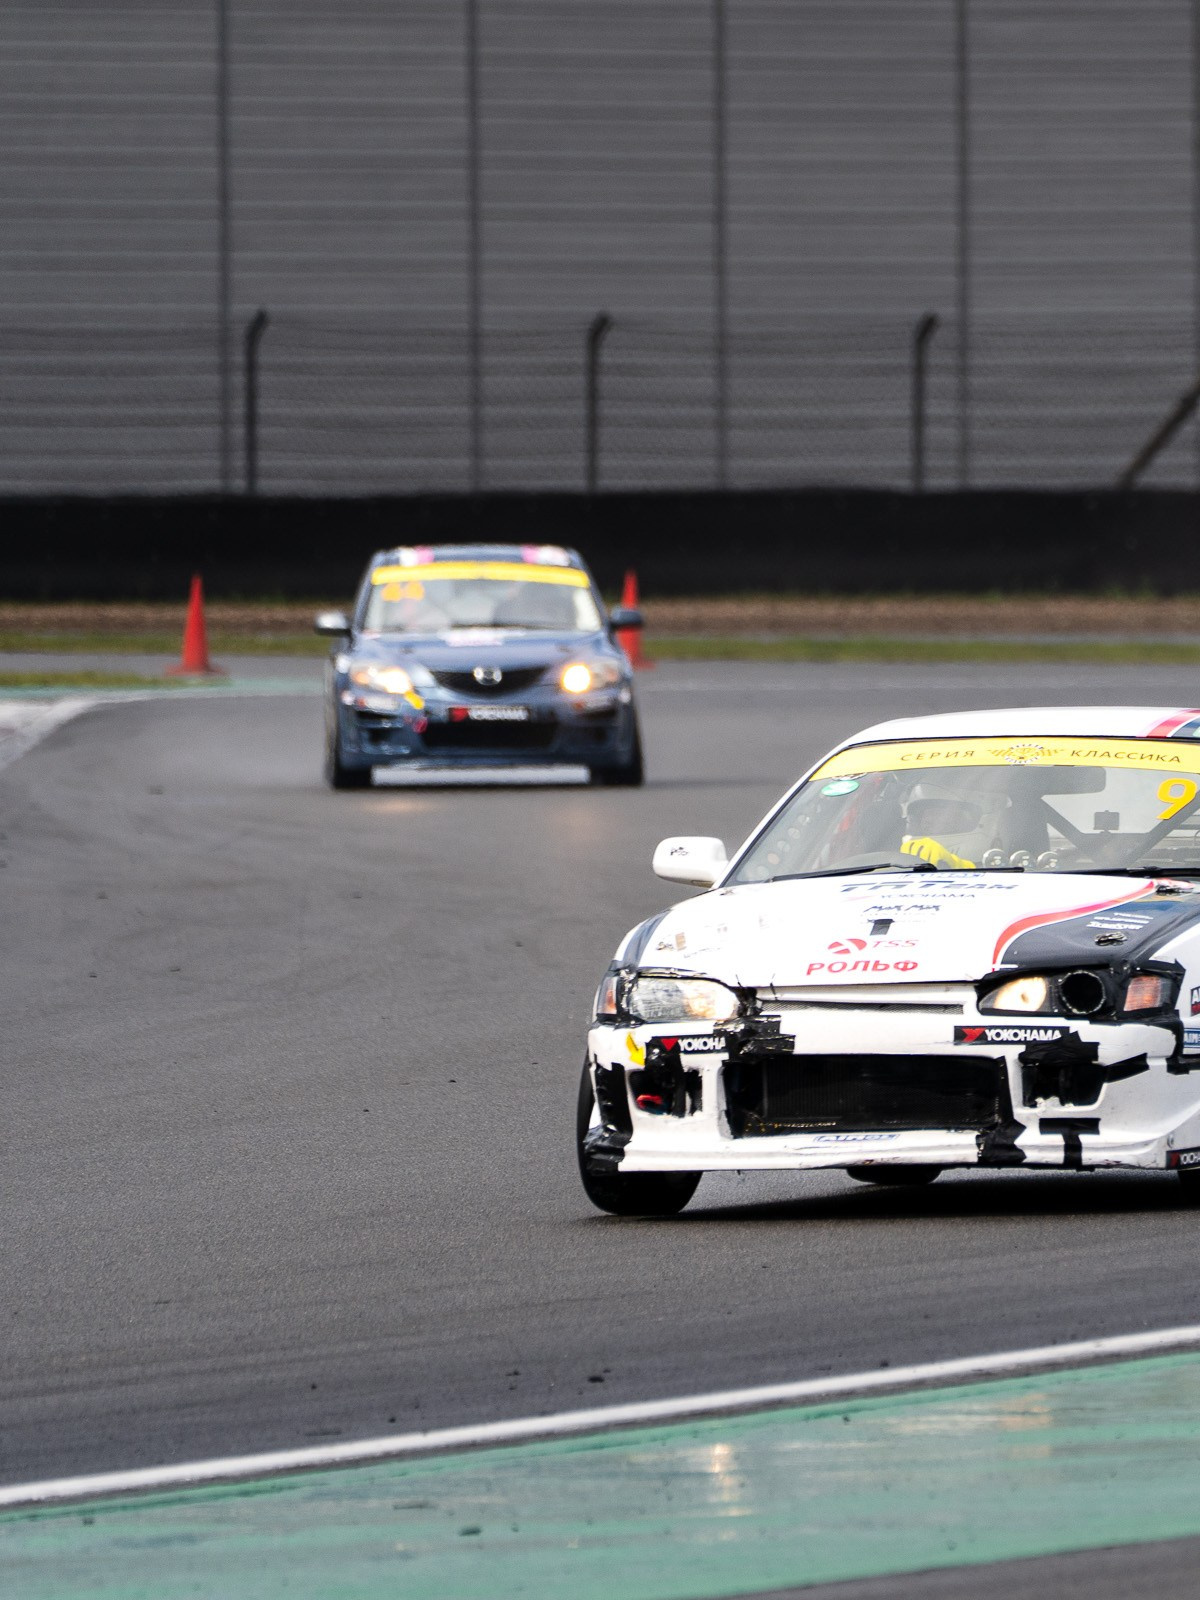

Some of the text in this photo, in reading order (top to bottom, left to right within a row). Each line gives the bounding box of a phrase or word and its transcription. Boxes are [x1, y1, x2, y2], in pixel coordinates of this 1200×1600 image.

[900, 749, 1182, 764] СЕРИЯ КЛАССИКА
[872, 939, 920, 948] TSS
[806, 959, 919, 976] РОЛЬФ
[984, 1028, 1062, 1041] YOKOHAMA
[678, 1036, 726, 1051] YOKOHA
